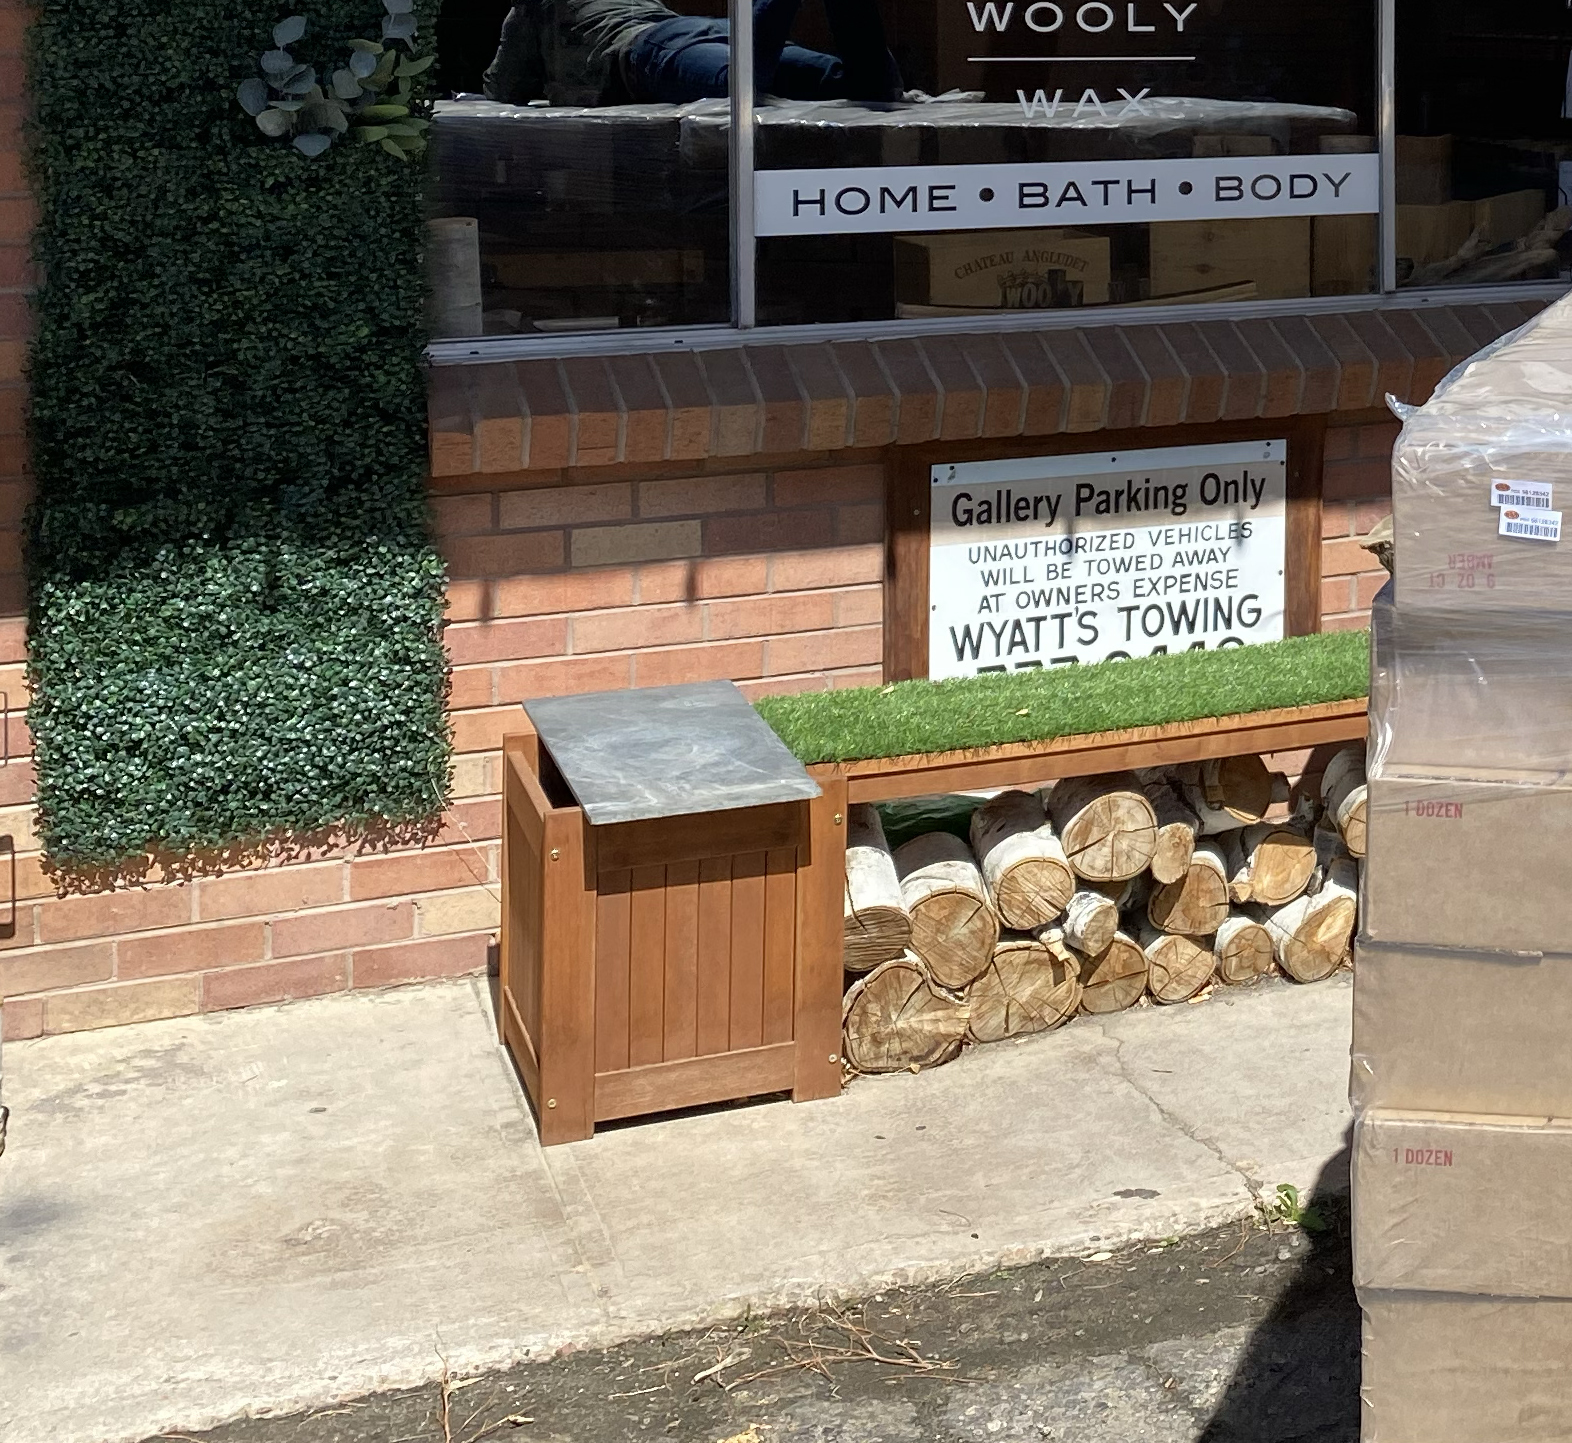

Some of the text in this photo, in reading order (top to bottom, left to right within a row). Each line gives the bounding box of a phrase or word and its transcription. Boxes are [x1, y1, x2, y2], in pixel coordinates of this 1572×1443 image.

[966, 1, 1197, 32] WOOLY
[1016, 87, 1153, 119] WAX
[792, 172, 1352, 217] HOME BATH BODY
[954, 250, 1014, 280] CHATEAU
[951, 470, 1267, 527] Gallery Parking Only
[969, 521, 1253, 565] UNAUTHORIZED VEHICLES
[1448, 553, 1494, 570] AMBER
[981, 546, 1231, 588] WILL BE TOWED AWAY
[978, 569, 1239, 614] AT OWNERS EXPENSE
[950, 607, 1098, 662] WYATT'S
[1117, 593, 1262, 642] TOWING
[1416, 801, 1463, 820] DOZEN
[1405, 1148, 1453, 1167] DOZEN
